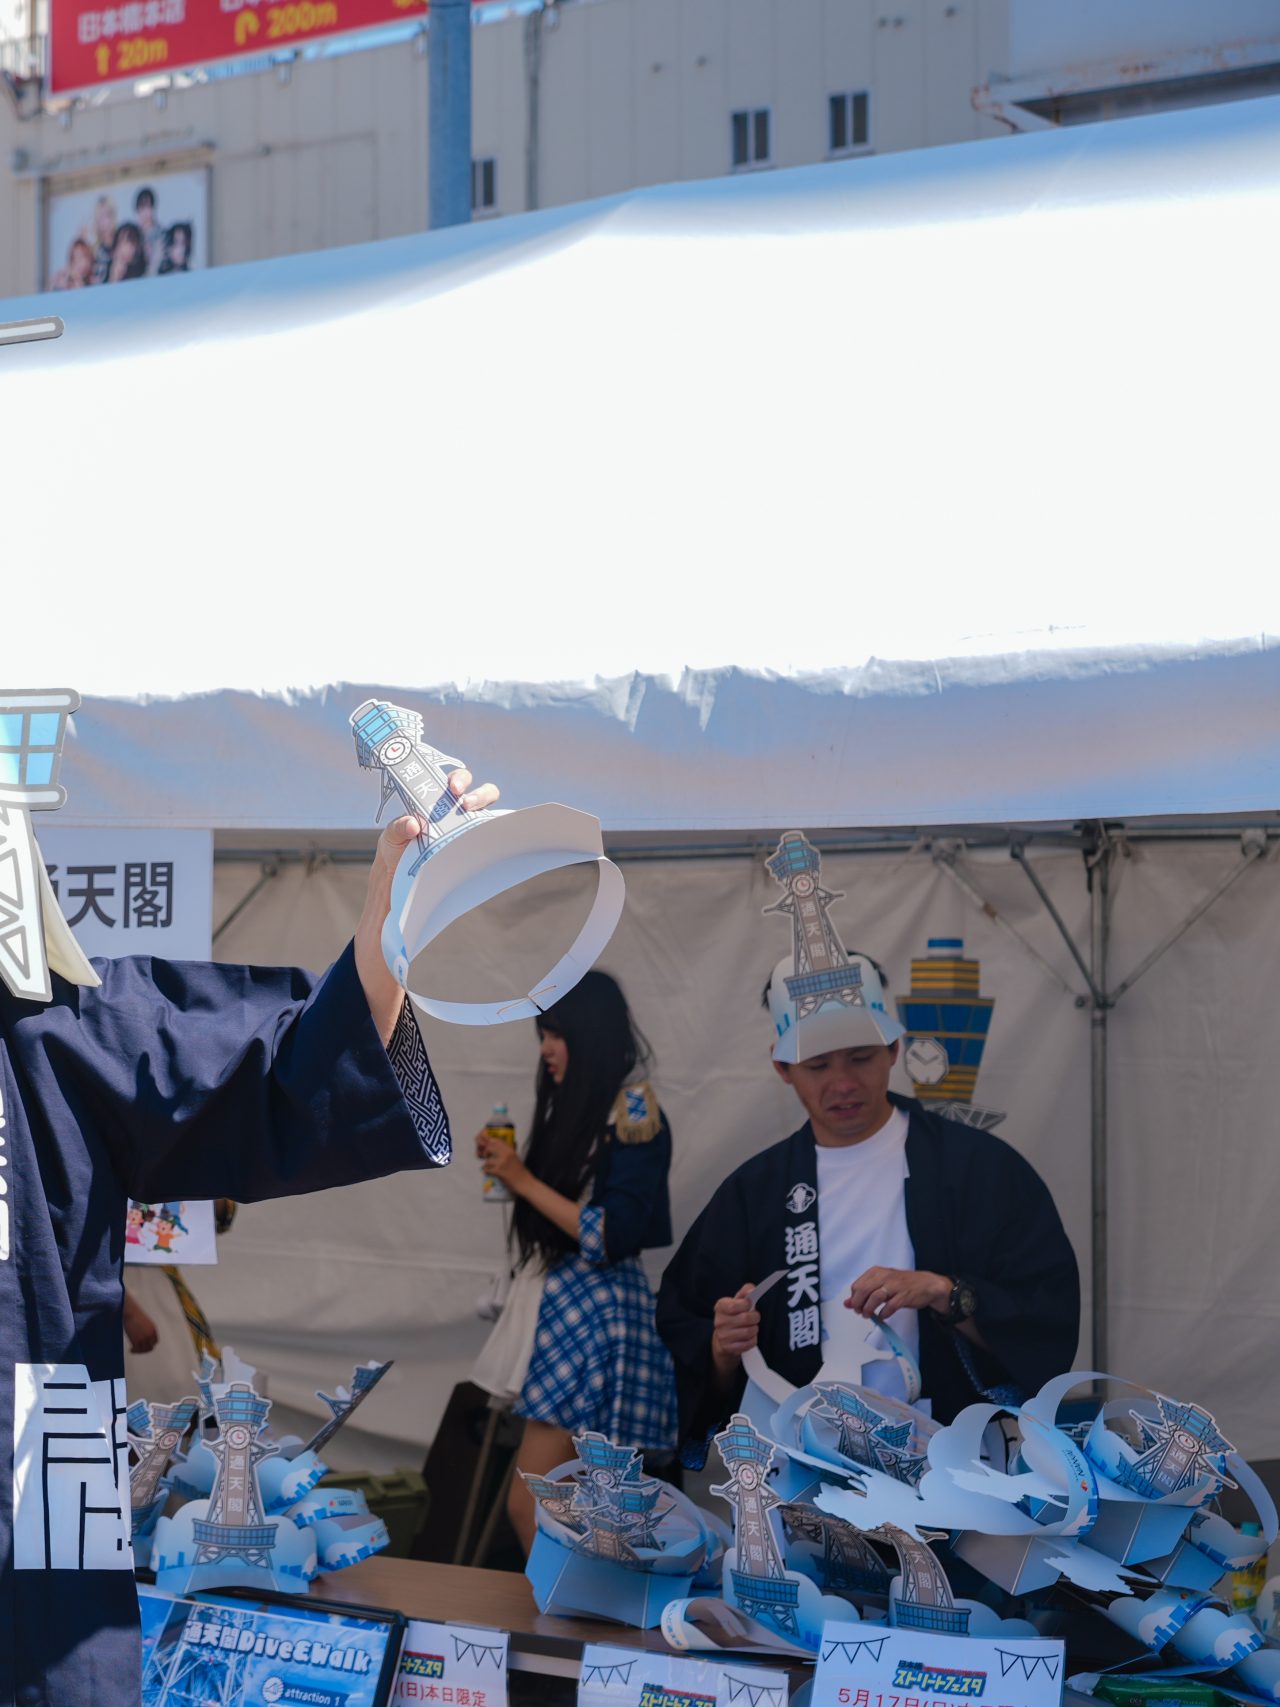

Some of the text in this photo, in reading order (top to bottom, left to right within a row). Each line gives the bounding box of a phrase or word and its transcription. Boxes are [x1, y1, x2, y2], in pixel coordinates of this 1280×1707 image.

[267, 2, 338, 38] 200m
[117, 37, 169, 70] 20m
[399, 760, 451, 820] 通天閣
[785, 1221, 820, 1352] 通天閣
[228, 1455, 245, 1512] 通天閣
[744, 1496, 764, 1562] 通天閣
[283, 1688, 341, 1706] attraction 1
[395, 1681, 487, 1707] (日)本日限定
[893, 1668, 985, 1696] ストリートフェスタ
